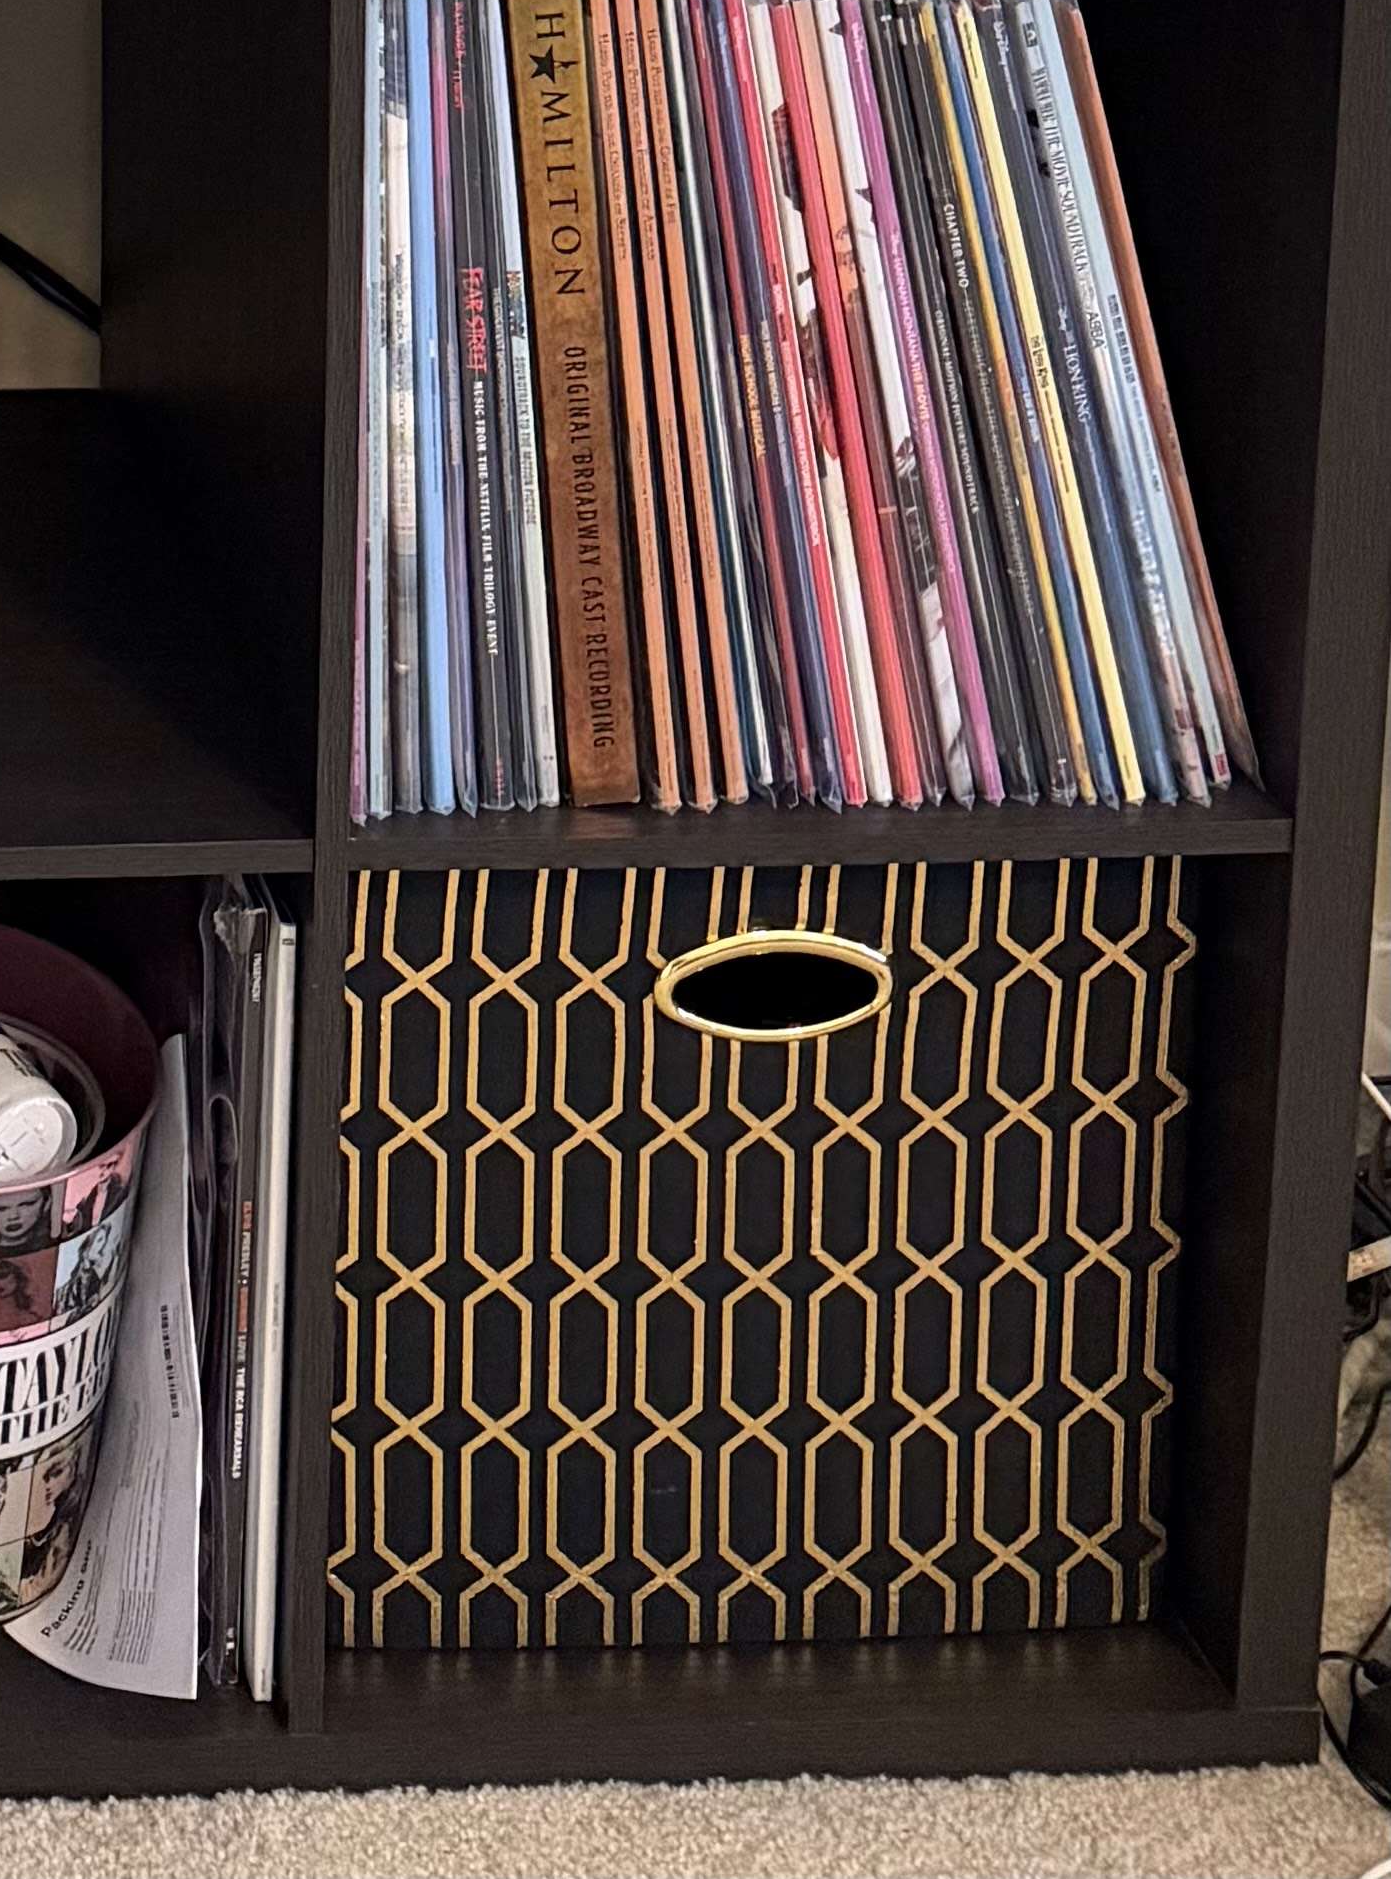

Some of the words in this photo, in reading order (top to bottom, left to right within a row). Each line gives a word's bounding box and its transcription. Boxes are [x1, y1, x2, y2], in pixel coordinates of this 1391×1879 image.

[942, 203, 963, 256] CHAPTER
[462, 267, 485, 313] FEAR
[891, 256, 909, 303] HANNAH
[952, 258, 969, 288] TWO
[465, 316, 487, 373] STREET
[473, 381, 485, 416] MUSIC
[563, 347, 593, 444] ORIGINAL
[475, 419, 487, 453] FROM
[519, 415, 530, 429] TO
[520, 430, 532, 448] THE
[749, 415, 766, 459] MUSICAL
[477, 456, 489, 479] THE
[478, 482, 491, 532] NETFLIX
[524, 489, 537, 526] PICTURE
[572, 454, 602, 567] BROADWAY
[481, 535, 493, 562] FILM
[483, 566, 496, 617] TRILOGY
[582, 576, 606, 625] CAST
[486, 620, 499, 656] EVENT
[585, 633, 615, 748] RECORDING
[240, 1230, 252, 1278] PRESLEY
[234, 1389, 245, 1411] RCA
[235, 1367, 246, 1389] THE
[231, 1412, 244, 1480] REHEARSALS
[39, 1579, 85, 1638] Packing
